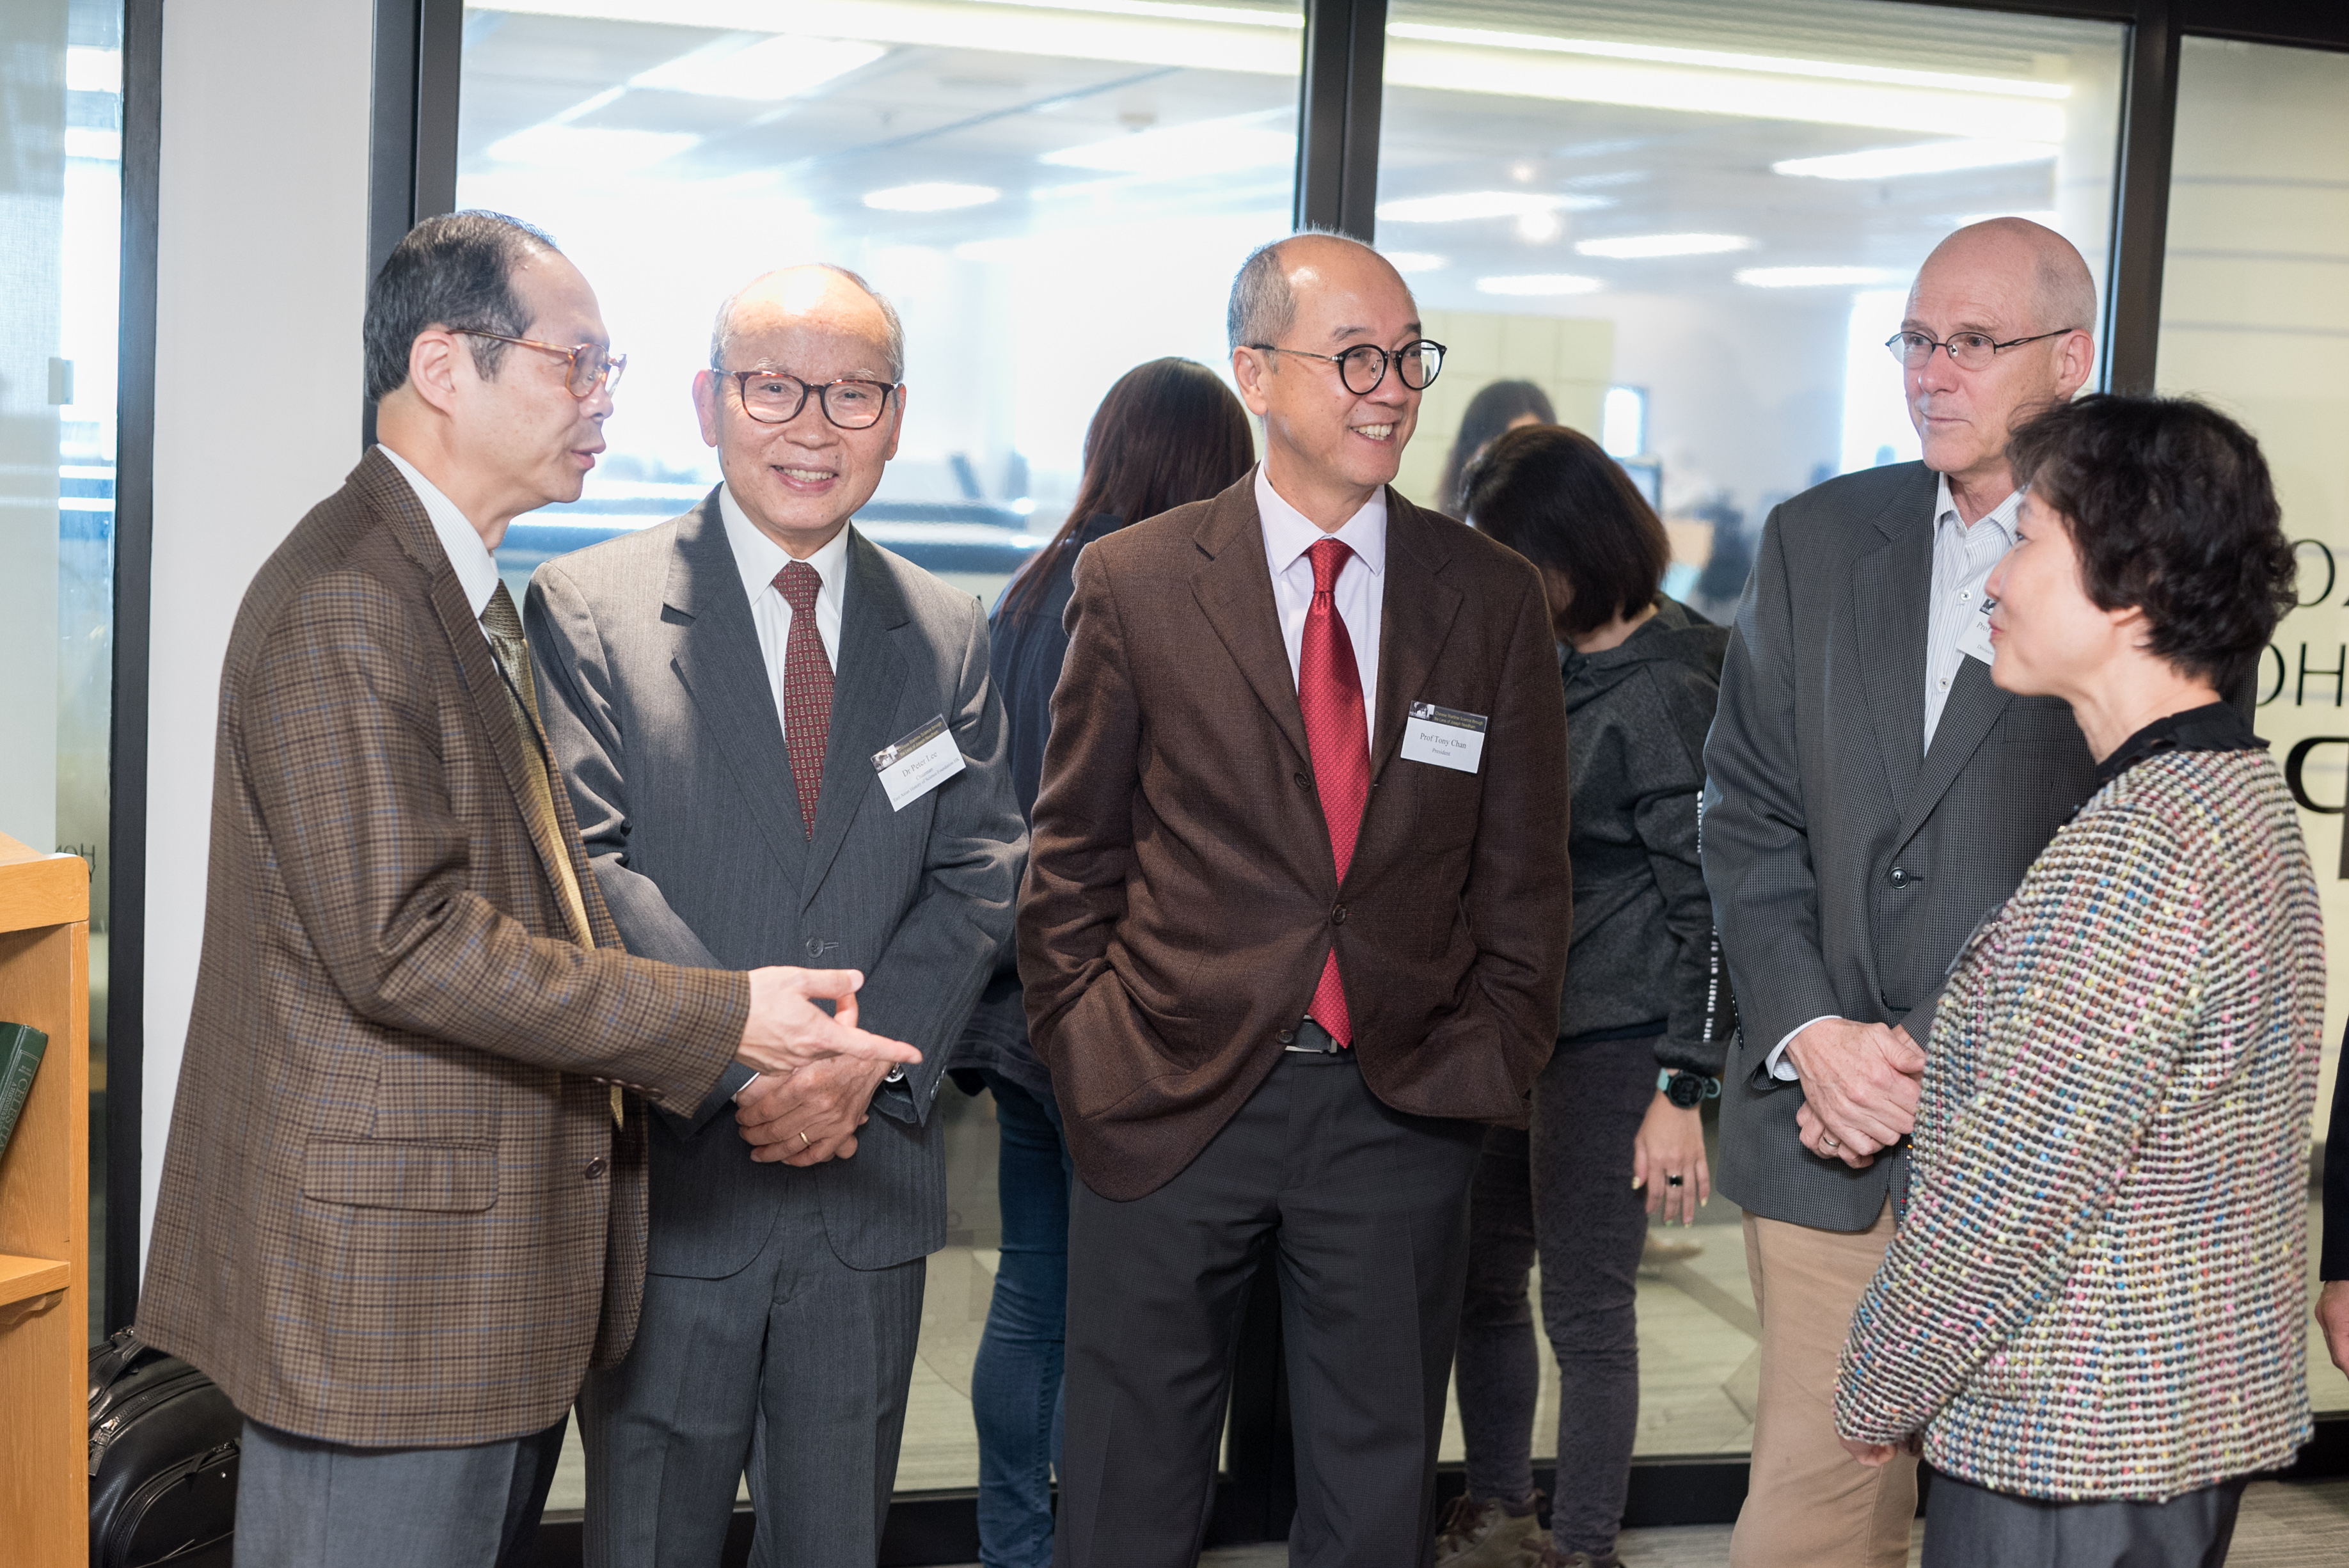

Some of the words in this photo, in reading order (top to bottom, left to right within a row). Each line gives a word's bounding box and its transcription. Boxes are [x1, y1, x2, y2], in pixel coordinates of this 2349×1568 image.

[1420, 733, 1434, 741] Prof
[1434, 736, 1450, 747] Tony
[1451, 739, 1467, 748] Chan
[1432, 747, 1451, 756] President
[902, 768, 911, 777] Dr
[911, 759, 927, 772] Peter
[926, 752, 938, 762] Lee
[916, 768, 933, 780] Chairman
[910, 783, 922, 792] History
[926, 773, 938, 782] Science
[937, 763, 954, 774] Foundation
[0, 1079, 28, 1149] CELESTIA
